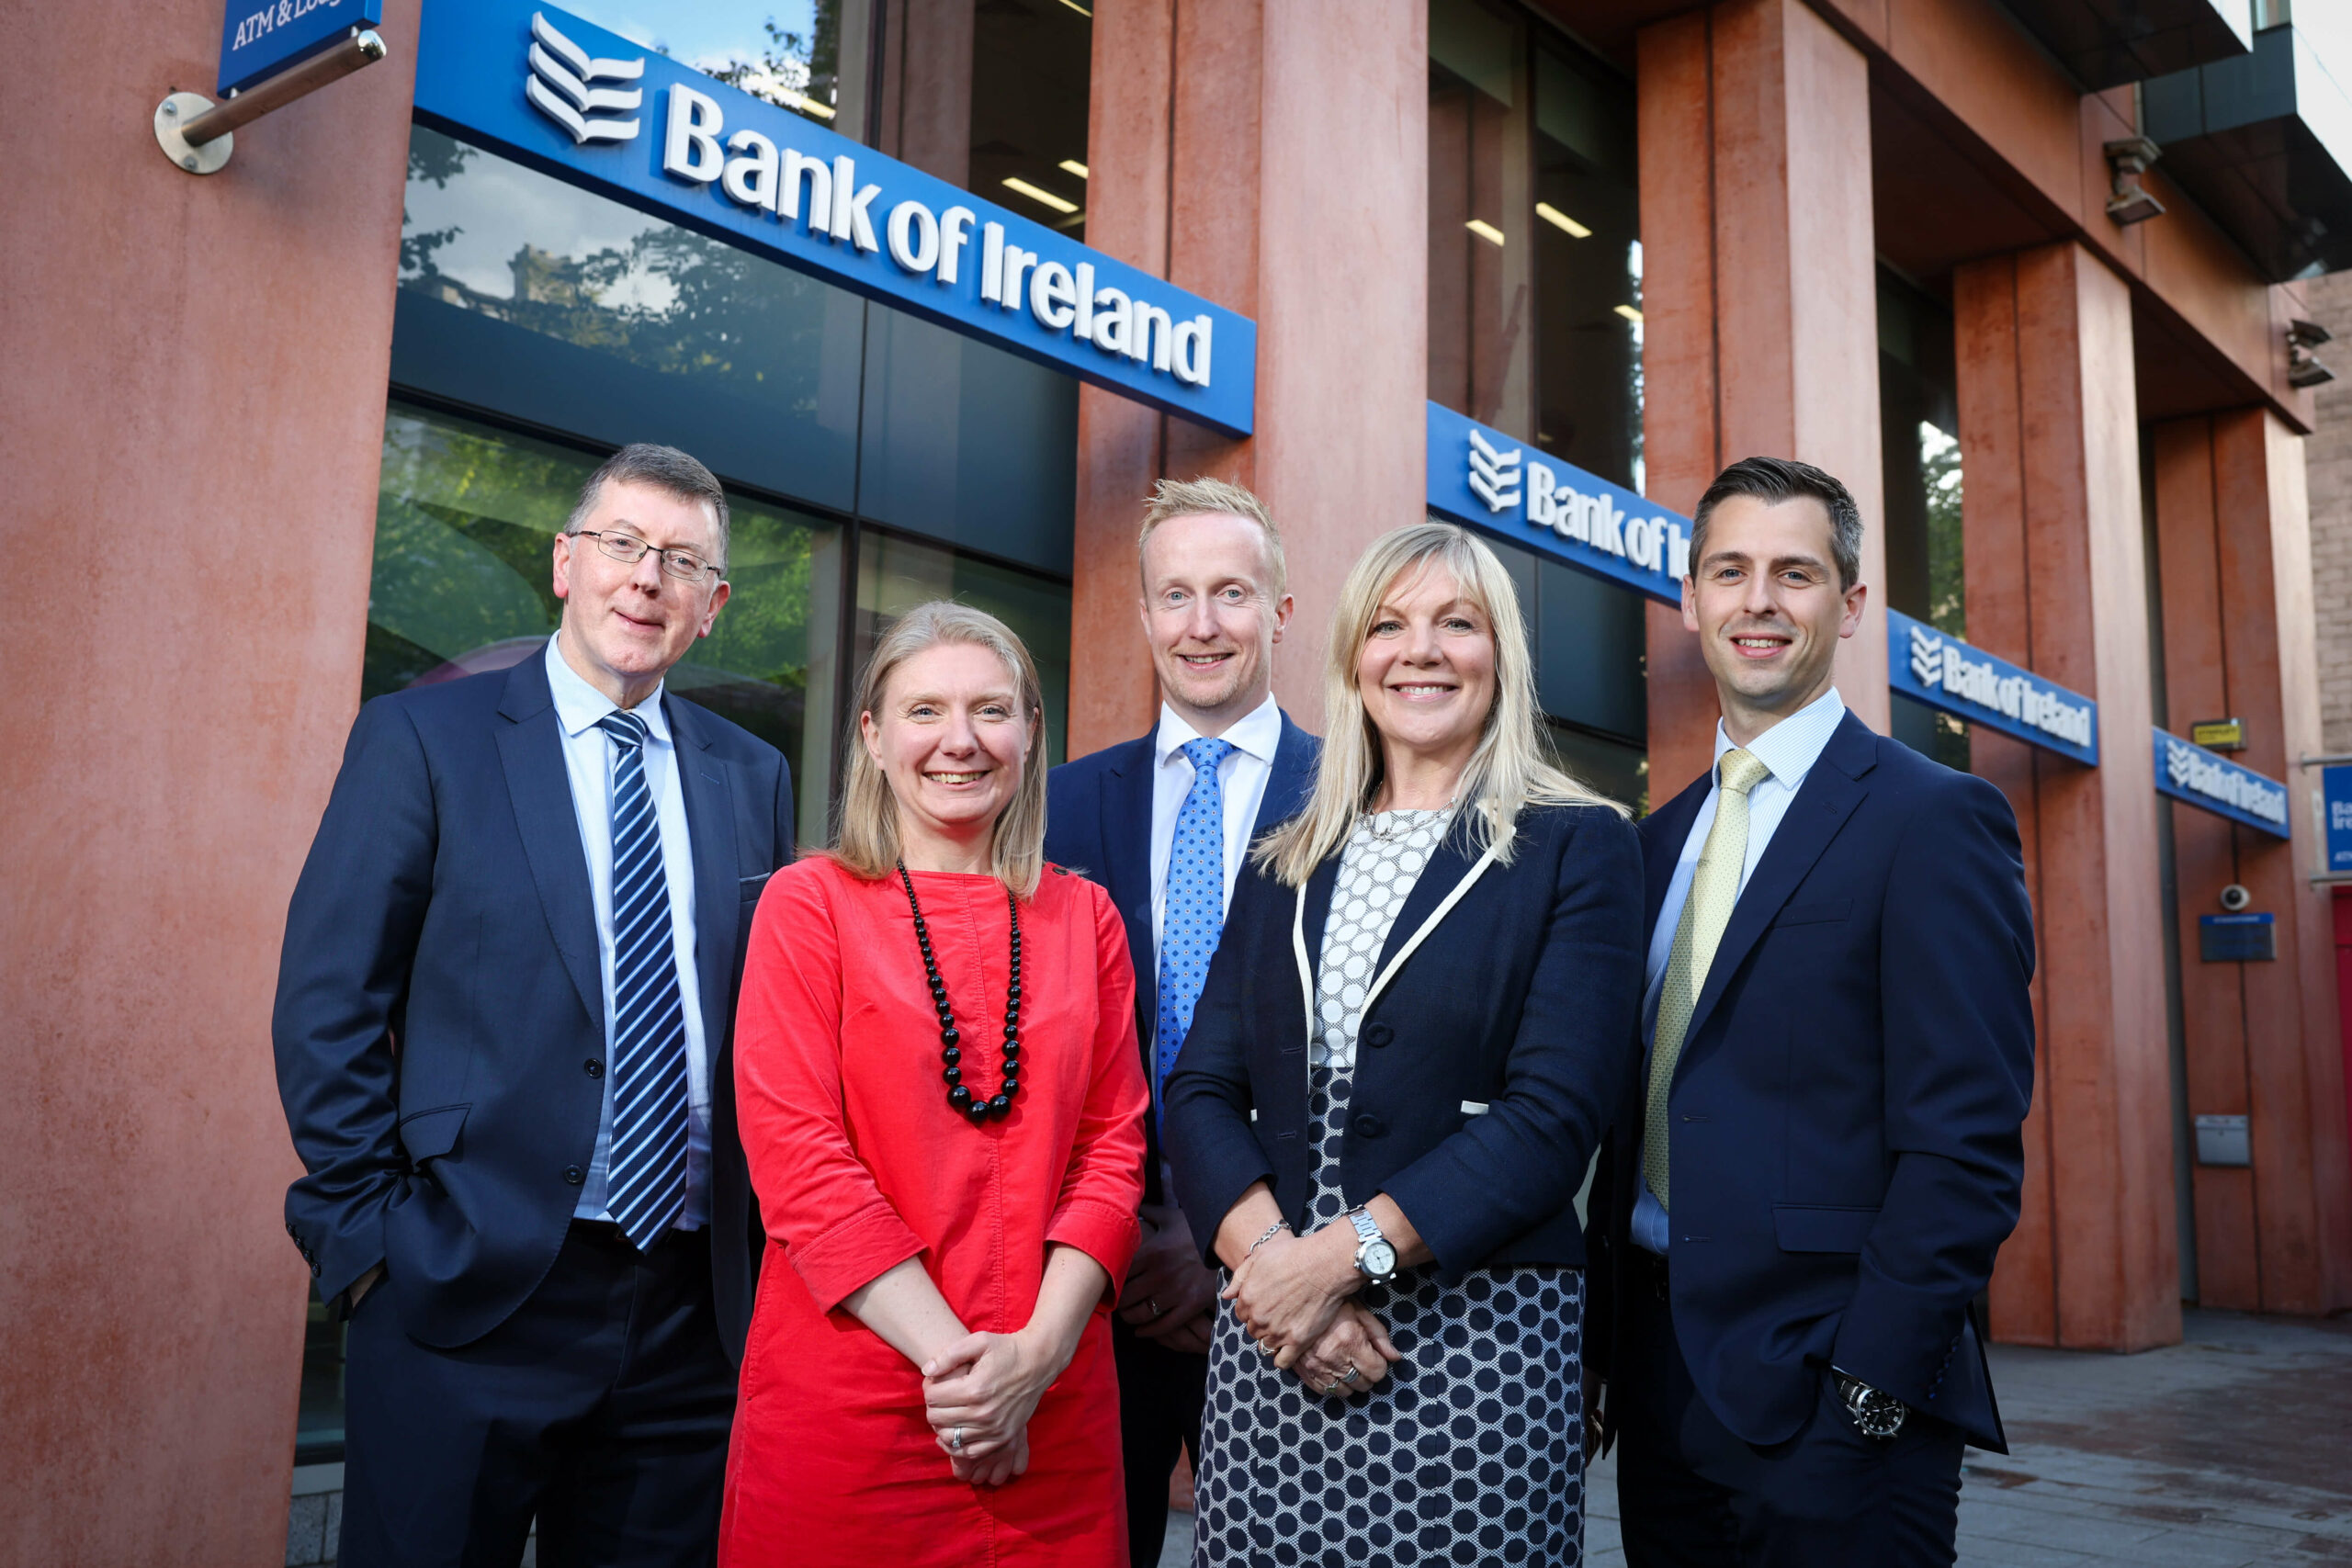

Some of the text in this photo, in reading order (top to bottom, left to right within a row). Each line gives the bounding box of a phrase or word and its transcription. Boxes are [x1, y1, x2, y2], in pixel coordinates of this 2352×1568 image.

[232, 5, 275, 51] ATM
[663, 83, 1213, 387] Bank of Ireland
[1527, 461, 1625, 558] Bank
[1624, 516, 1668, 571] of
[1943, 645, 2091, 748] Bank of Ireland
